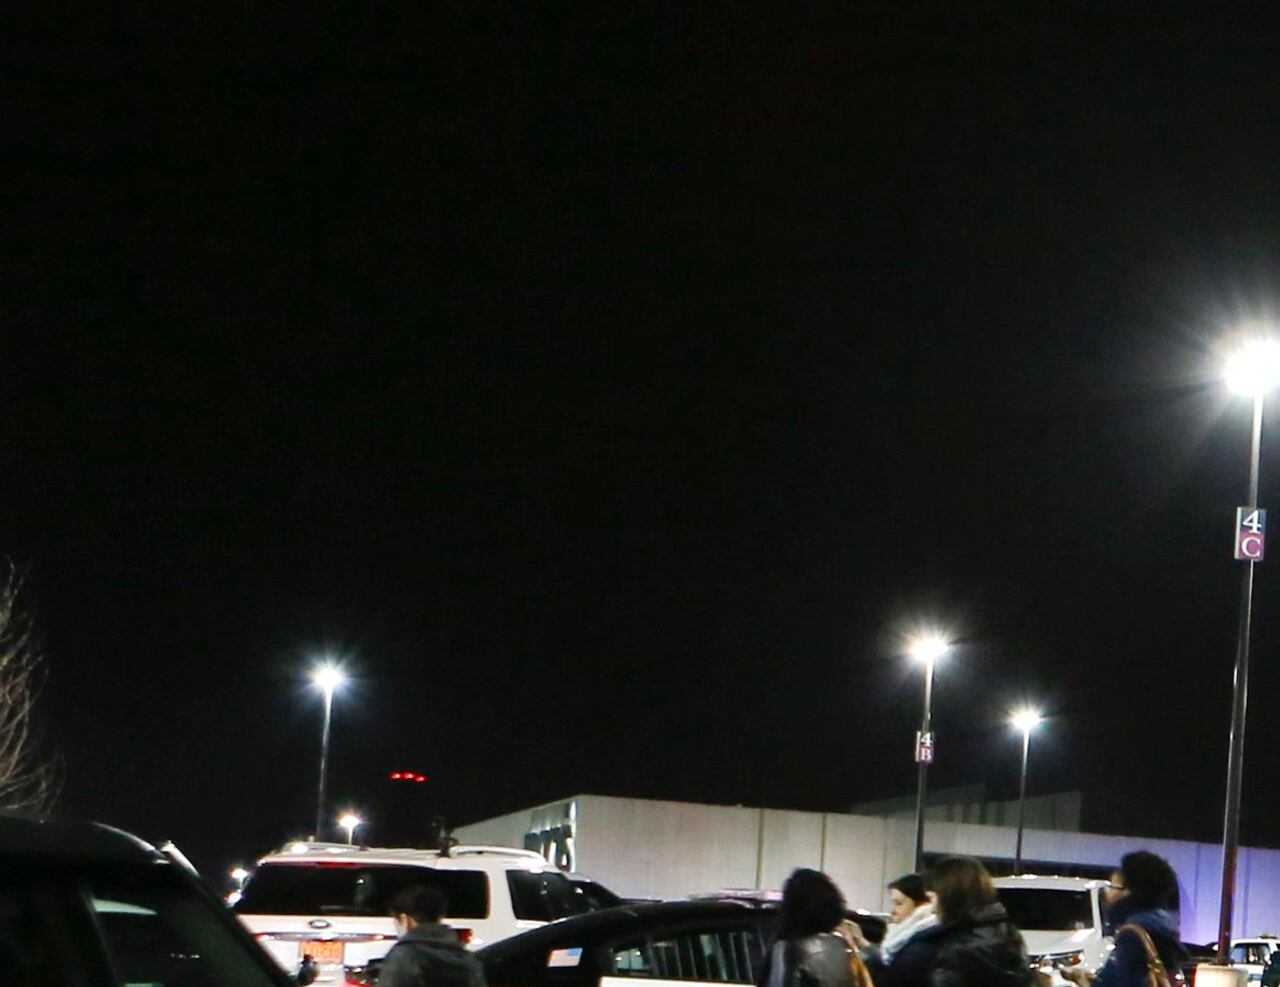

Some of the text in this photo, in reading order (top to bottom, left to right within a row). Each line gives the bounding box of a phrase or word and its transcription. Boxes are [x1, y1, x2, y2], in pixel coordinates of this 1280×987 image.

[1242, 509, 1262, 534] 4
[1241, 536, 1261, 558] C
[920, 732, 933, 747] 4
